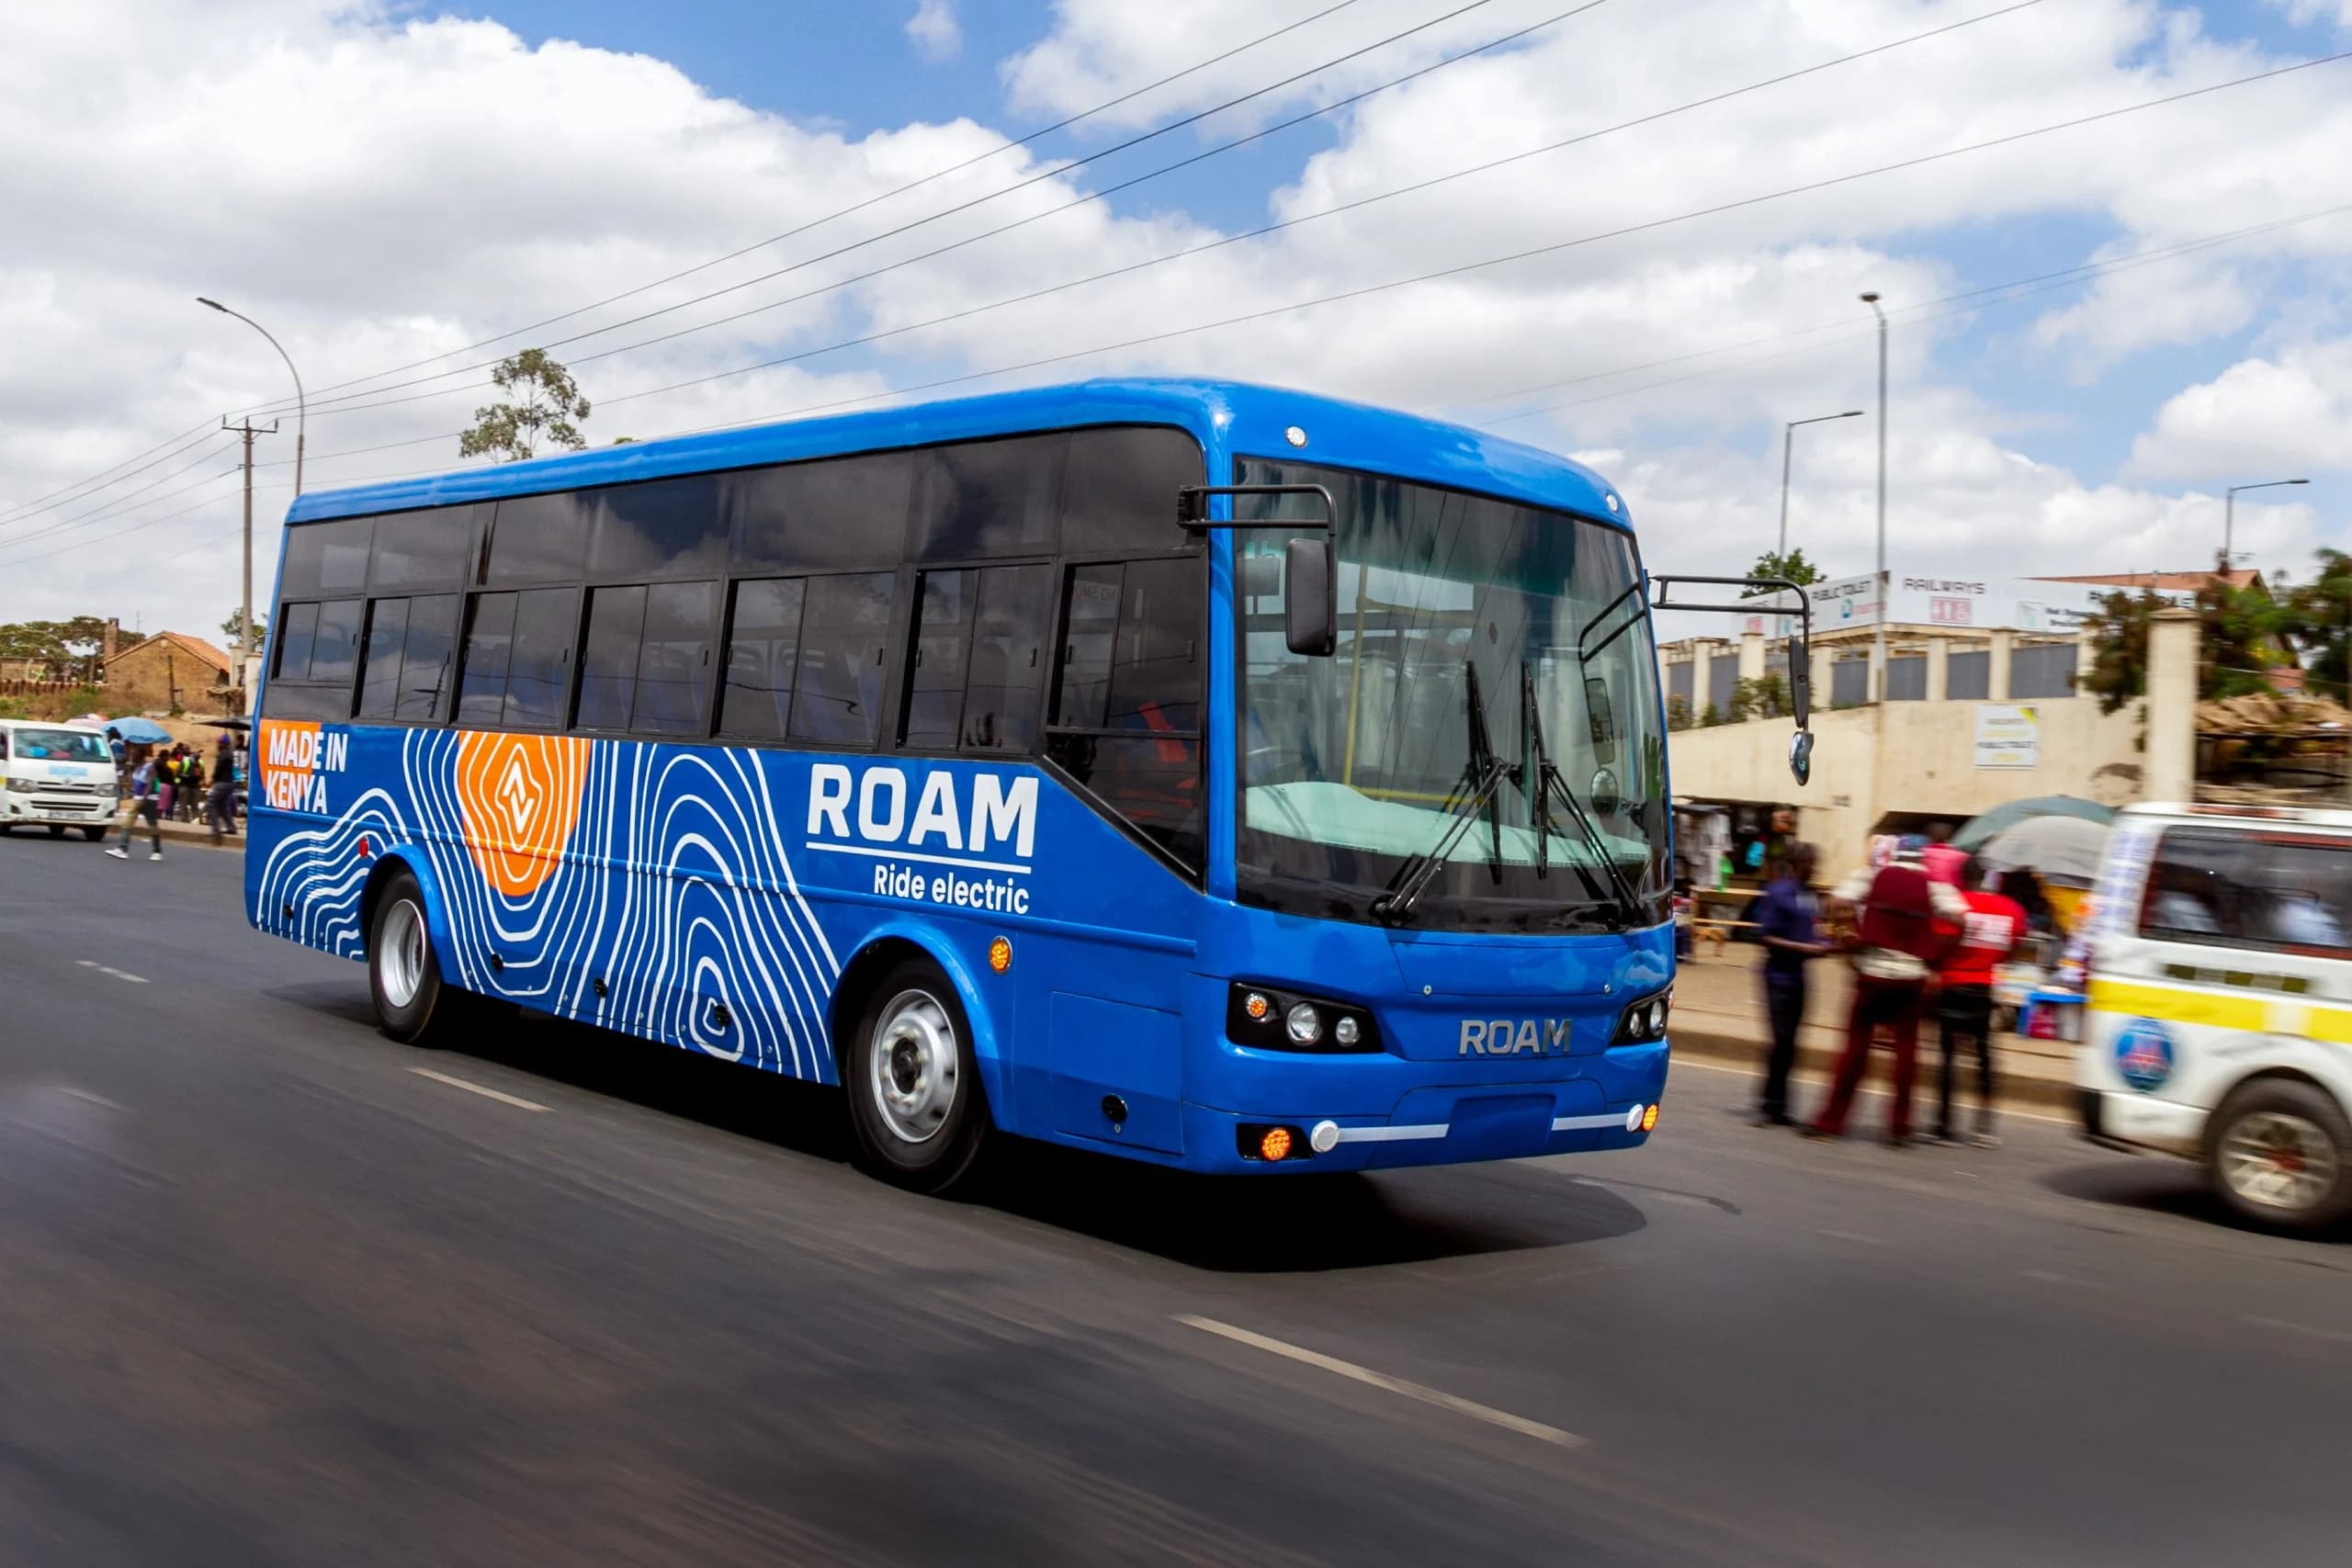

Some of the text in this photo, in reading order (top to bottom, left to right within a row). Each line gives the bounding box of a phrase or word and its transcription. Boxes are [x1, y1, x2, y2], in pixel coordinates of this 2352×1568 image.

[1904, 578, 1985, 595] RAILWAYS
[268, 728, 348, 773] MADE IN
[266, 770, 328, 815] KENYA
[807, 763, 1039, 857] ROAM
[874, 863, 1030, 915] Ride electric
[1459, 1019, 1574, 1055] ROAM
